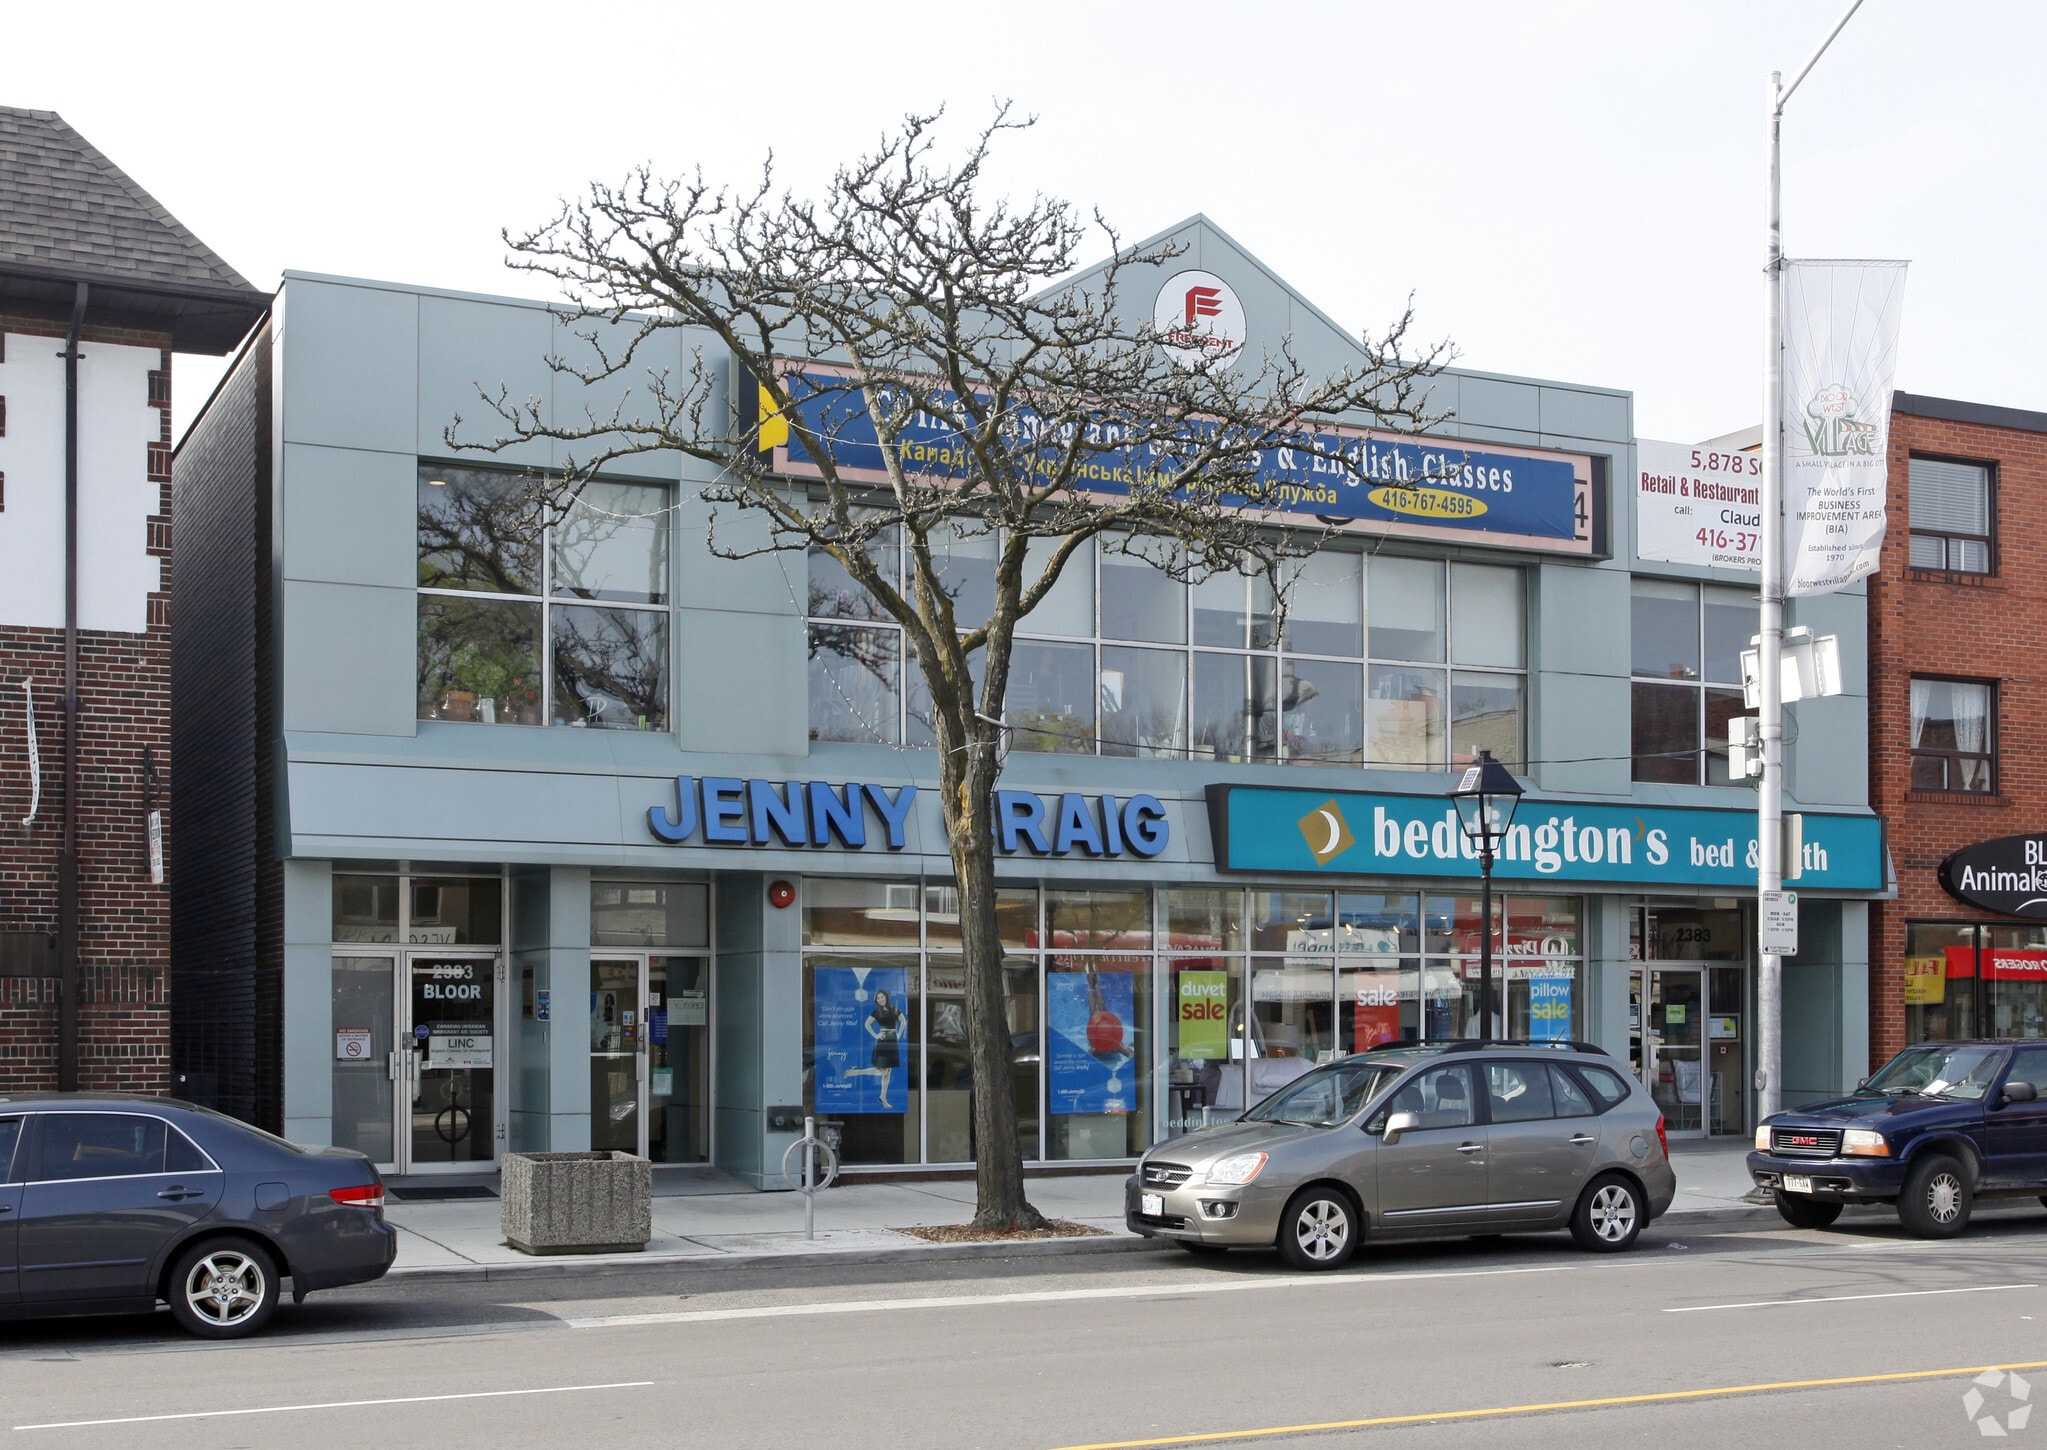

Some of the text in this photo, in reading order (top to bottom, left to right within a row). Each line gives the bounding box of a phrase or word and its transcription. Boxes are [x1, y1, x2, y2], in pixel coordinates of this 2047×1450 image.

[1823, 403, 1845, 413] WEST
[1312, 442, 1408, 488] English
[1423, 453, 1512, 493] Classes
[1691, 450, 1762, 476] 5,878 S
[1641, 472, 1759, 505] Retail & Restaurant
[1808, 487, 1875, 496] The World's First
[1382, 489, 1473, 516] 416-767-4595
[1674, 505, 1693, 515] call:
[1818, 500, 1860, 510] BUSINESS
[1796, 511, 1860, 521] IMPROVEMENT
[1825, 524, 1848, 535] (BIA)
[1695, 527, 1762, 552] 416-37
[1808, 544, 1846, 552] Established
[1712, 553, 1745, 564] (BROKERS
[1797, 560, 1870, 589] bloorwestvillag.com
[647, 775, 1170, 858] JENNY RAIG
[1374, 806, 1669, 873] beddngton's
[1690, 836, 1734, 868] bed
[1960, 865, 2036, 892] Animal
[1677, 928, 1711, 942] 2383
[424, 984, 481, 1000] BLOOR
[1182, 981, 1226, 997] duvet
[1357, 984, 1397, 1006] sale
[1530, 983, 1569, 999] pillow
[1182, 998, 1225, 1020] sale
[1532, 998, 1569, 1019] sale
[448, 1039, 475, 1048] LINC
[826, 1048, 848, 1061] jenny
[1162, 1116, 1231, 1128] beddinton
[1792, 1136, 1818, 1145] GMC
